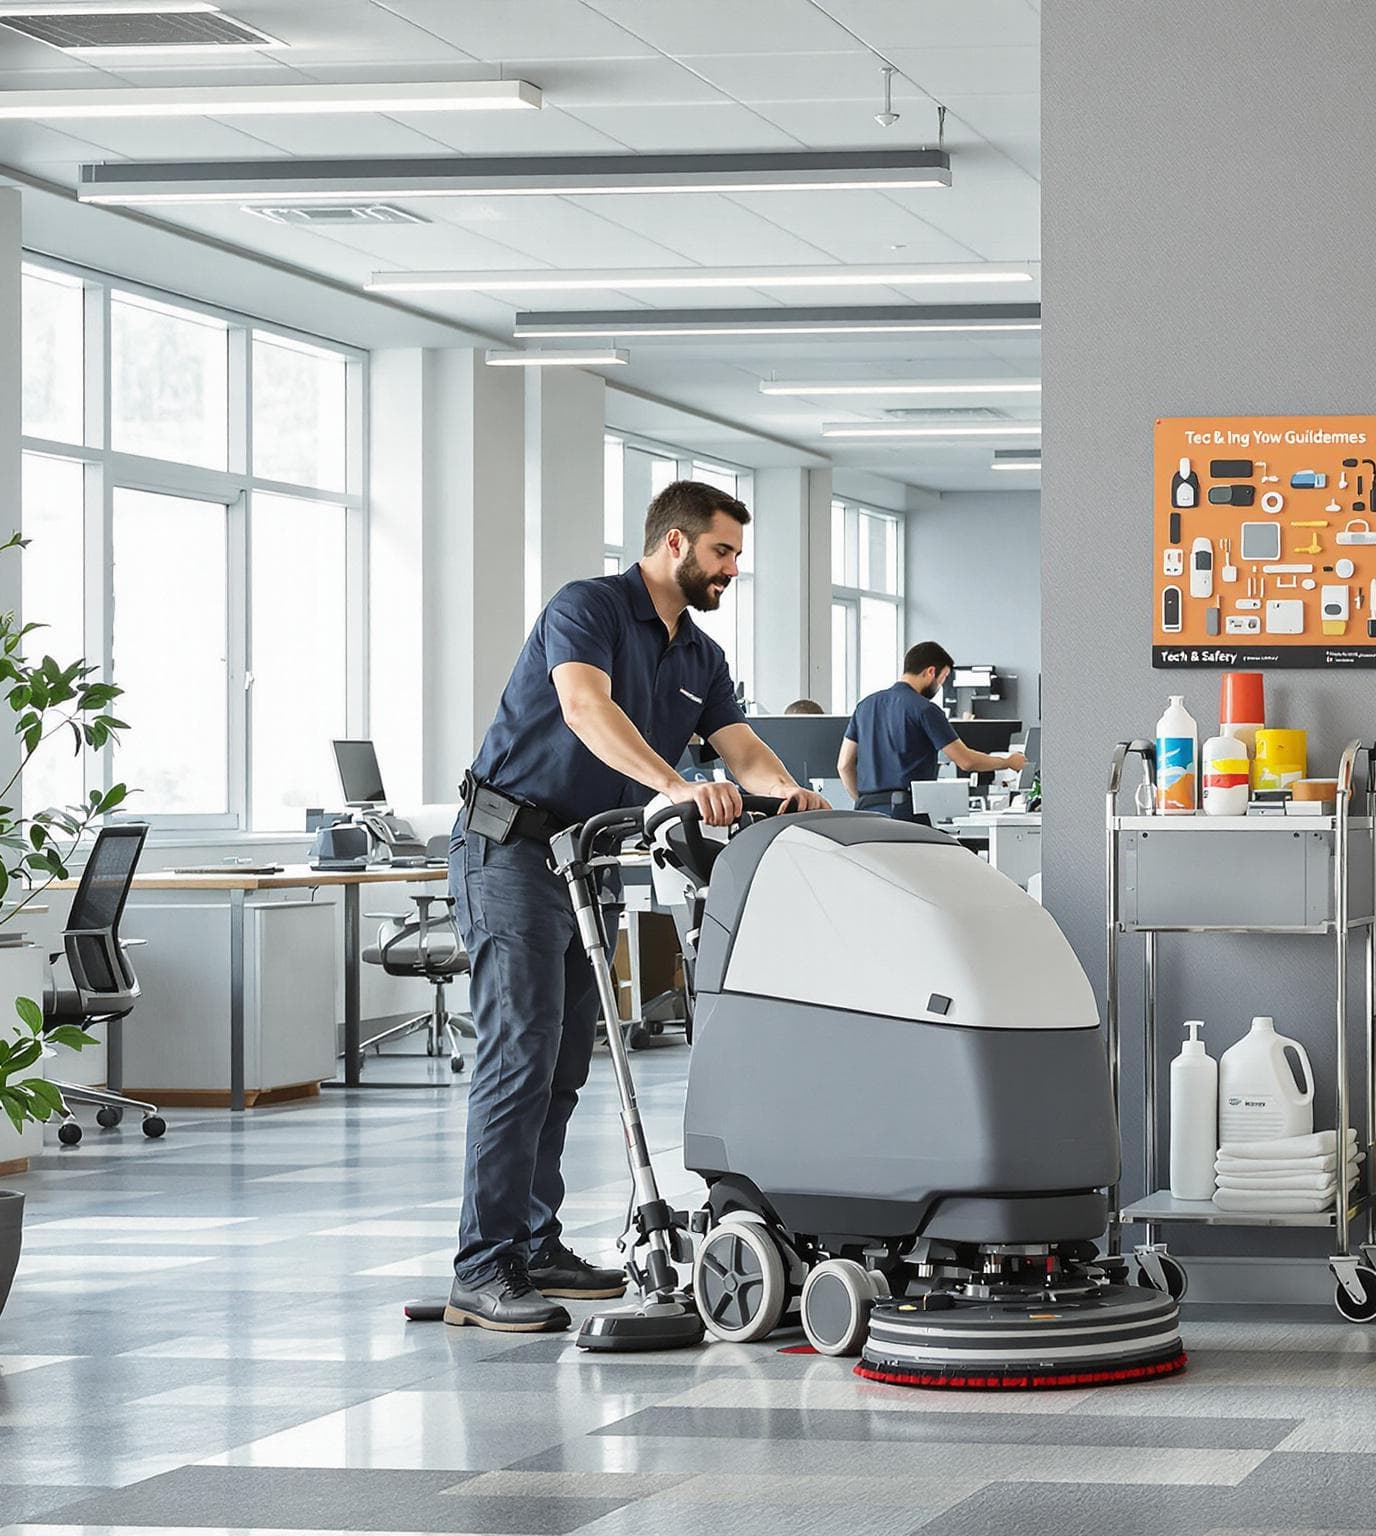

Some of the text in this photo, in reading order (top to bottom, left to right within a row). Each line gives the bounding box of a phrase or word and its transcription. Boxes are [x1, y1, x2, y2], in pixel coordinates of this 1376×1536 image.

[1184, 430, 1211, 444] Tec
[1213, 430, 1224, 444] &
[1252, 430, 1282, 444] Yow
[1190, 651, 1200, 662] &
